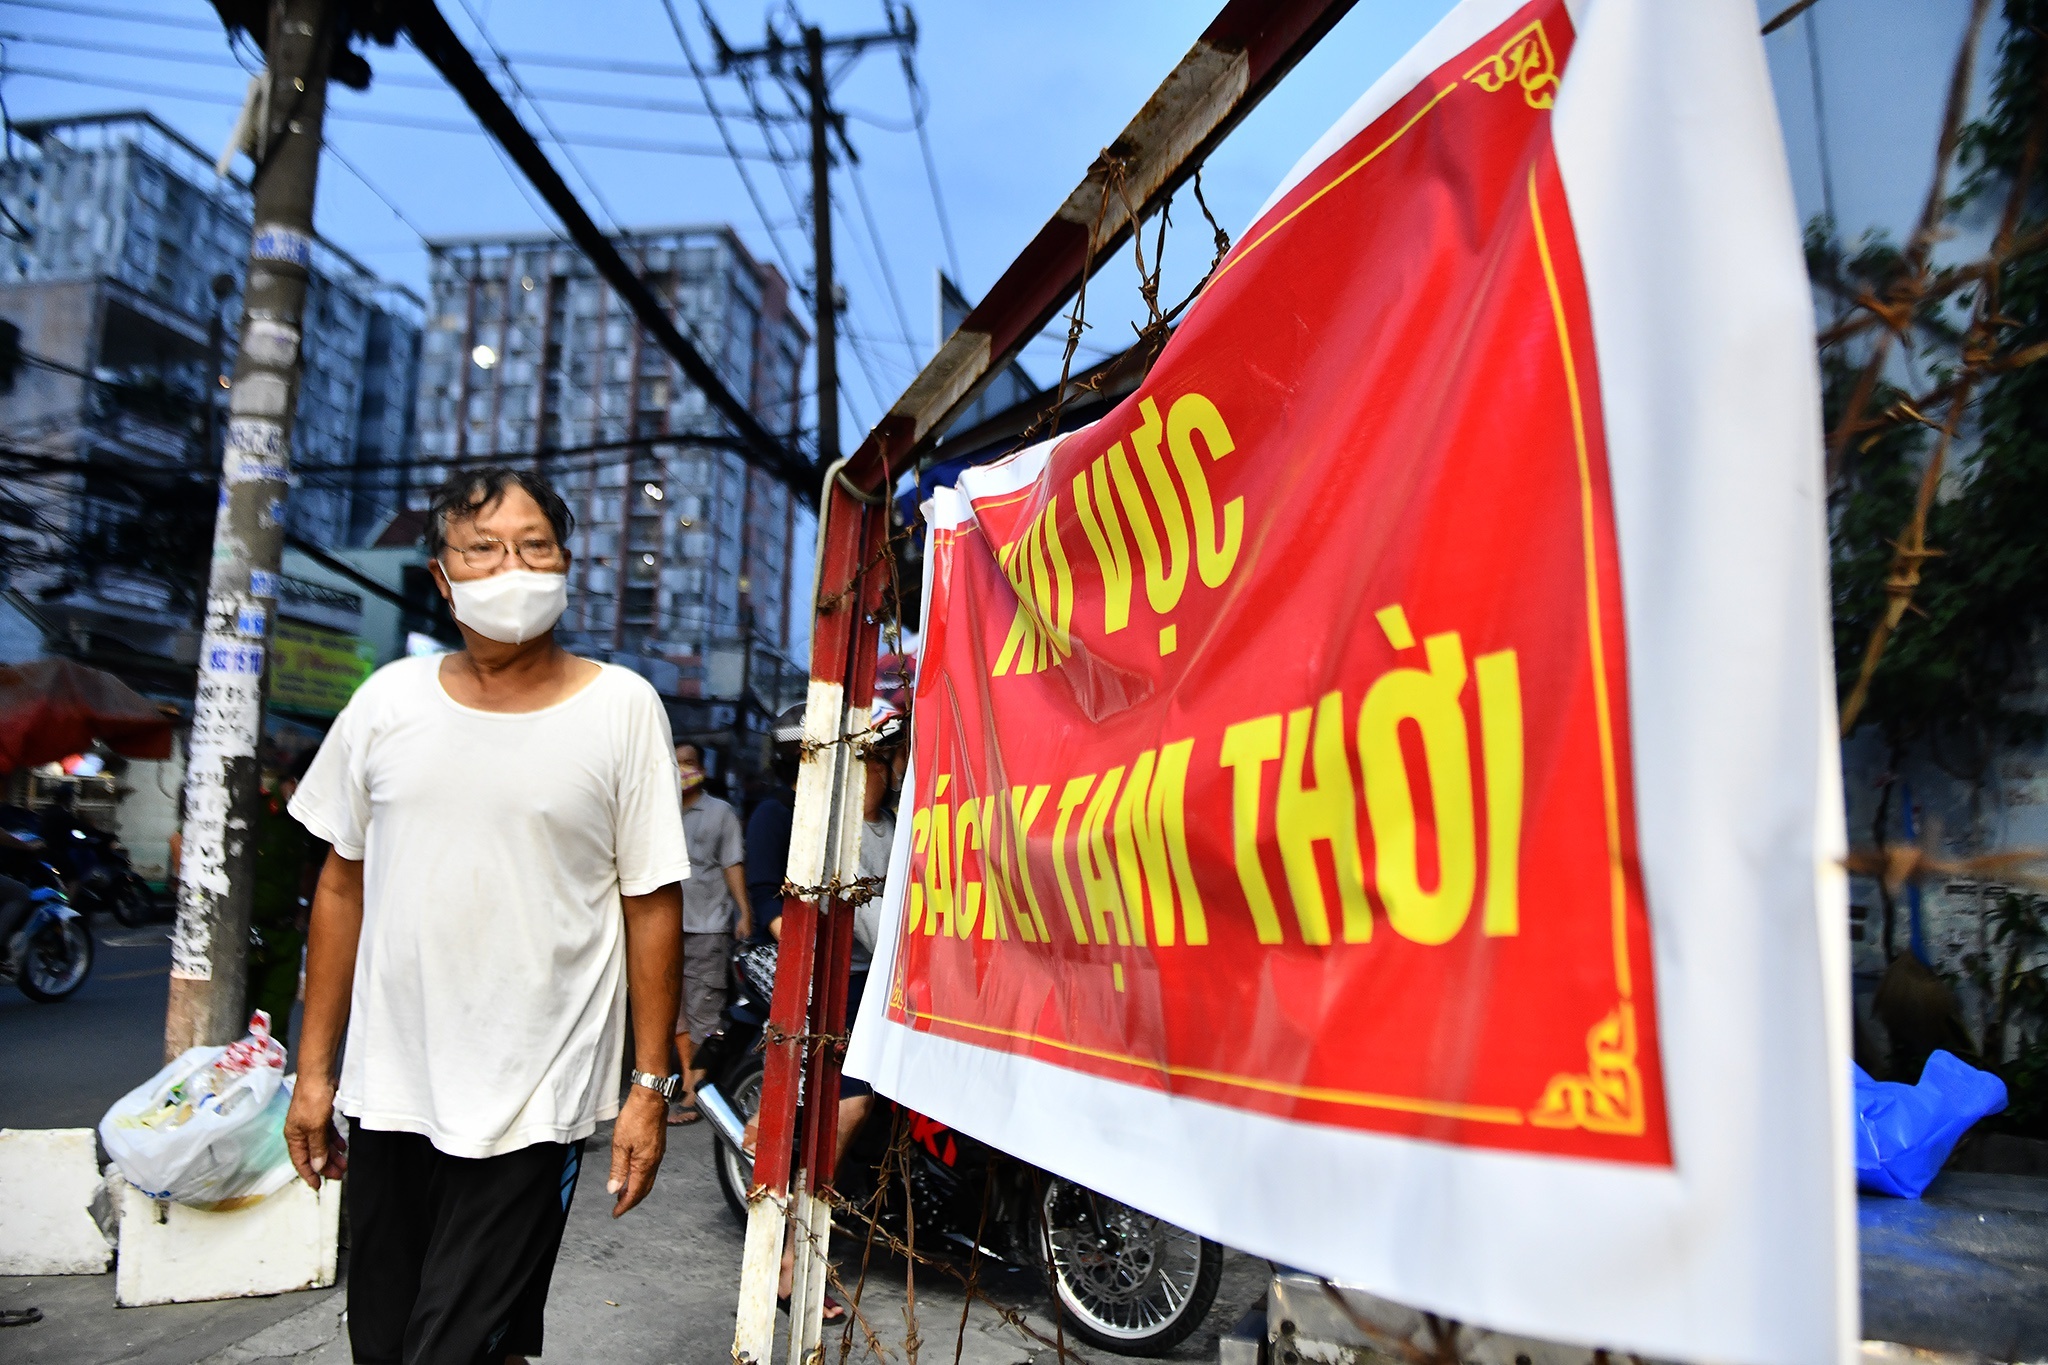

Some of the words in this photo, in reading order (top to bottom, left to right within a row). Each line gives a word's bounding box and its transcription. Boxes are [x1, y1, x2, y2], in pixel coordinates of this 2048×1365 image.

[1072, 393, 1245, 657] VỰC
[1052, 737, 1209, 993] TẠM
[1219, 604, 1524, 947] THỜI
